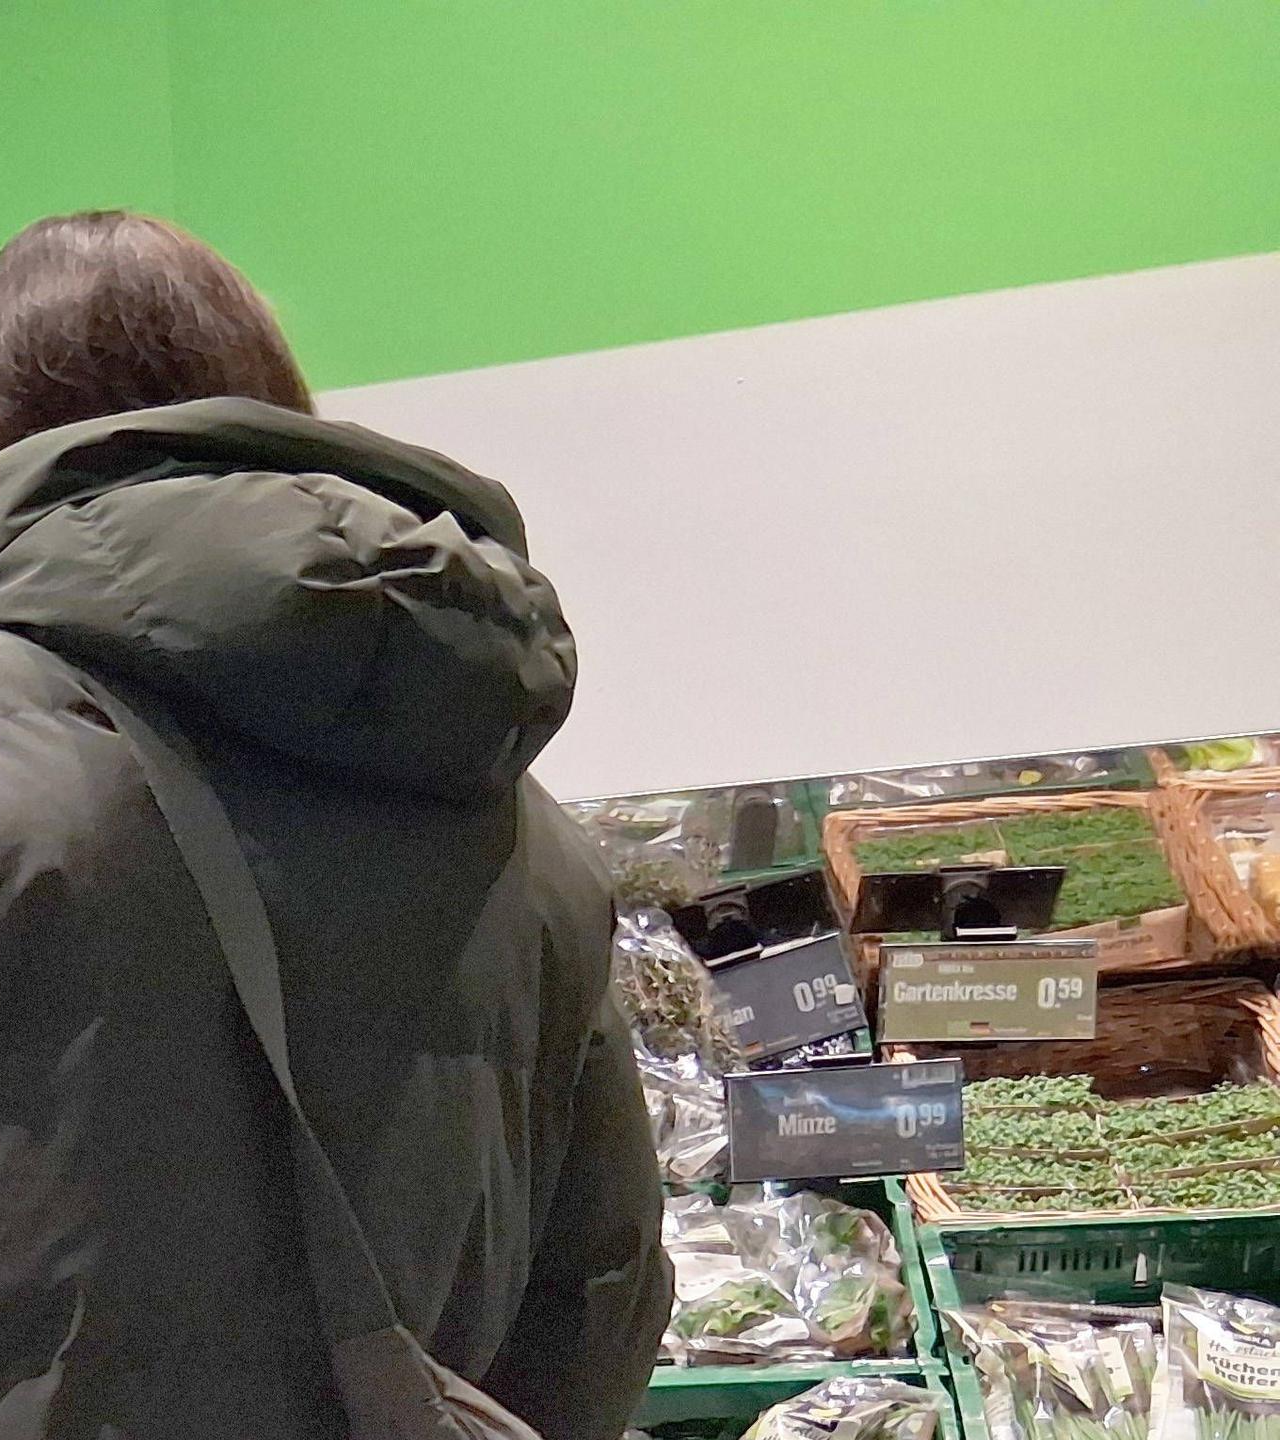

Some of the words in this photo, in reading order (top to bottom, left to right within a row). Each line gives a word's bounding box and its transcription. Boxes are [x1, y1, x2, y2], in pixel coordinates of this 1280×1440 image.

[893, 980, 1018, 1004] Gartenkresse
[1037, 977, 1083, 1009] 0.59
[778, 1112, 837, 1137] Minze
[896, 1102, 946, 1139] 0.99
